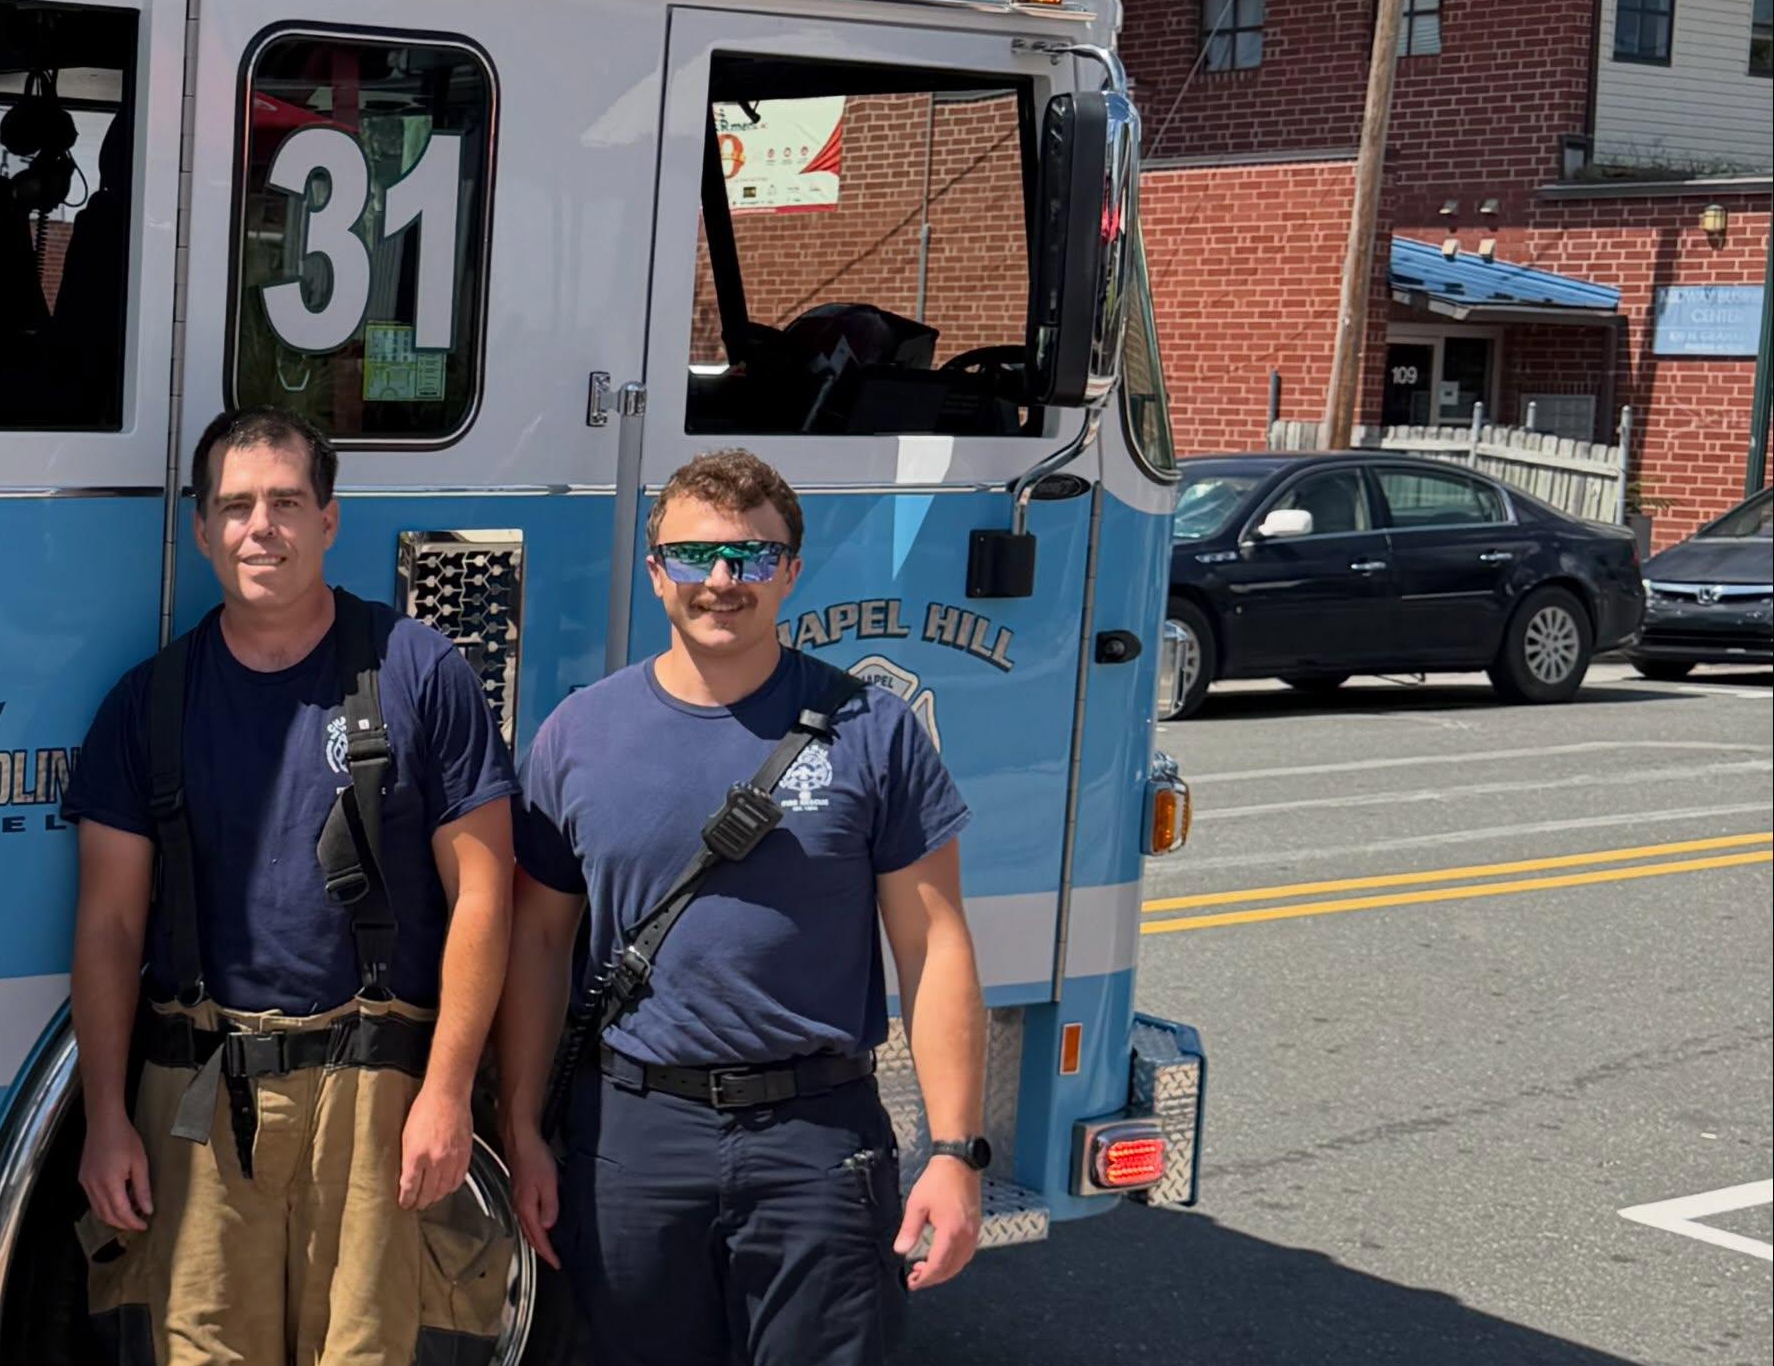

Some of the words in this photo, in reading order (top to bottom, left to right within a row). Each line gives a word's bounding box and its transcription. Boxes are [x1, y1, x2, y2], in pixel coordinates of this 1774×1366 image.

[265, 128, 462, 352] 31
[1391, 366, 1418, 385] 109
[775, 598, 912, 650] APEL
[922, 601, 1015, 673] HILL
[861, 674, 894, 690] APEL
